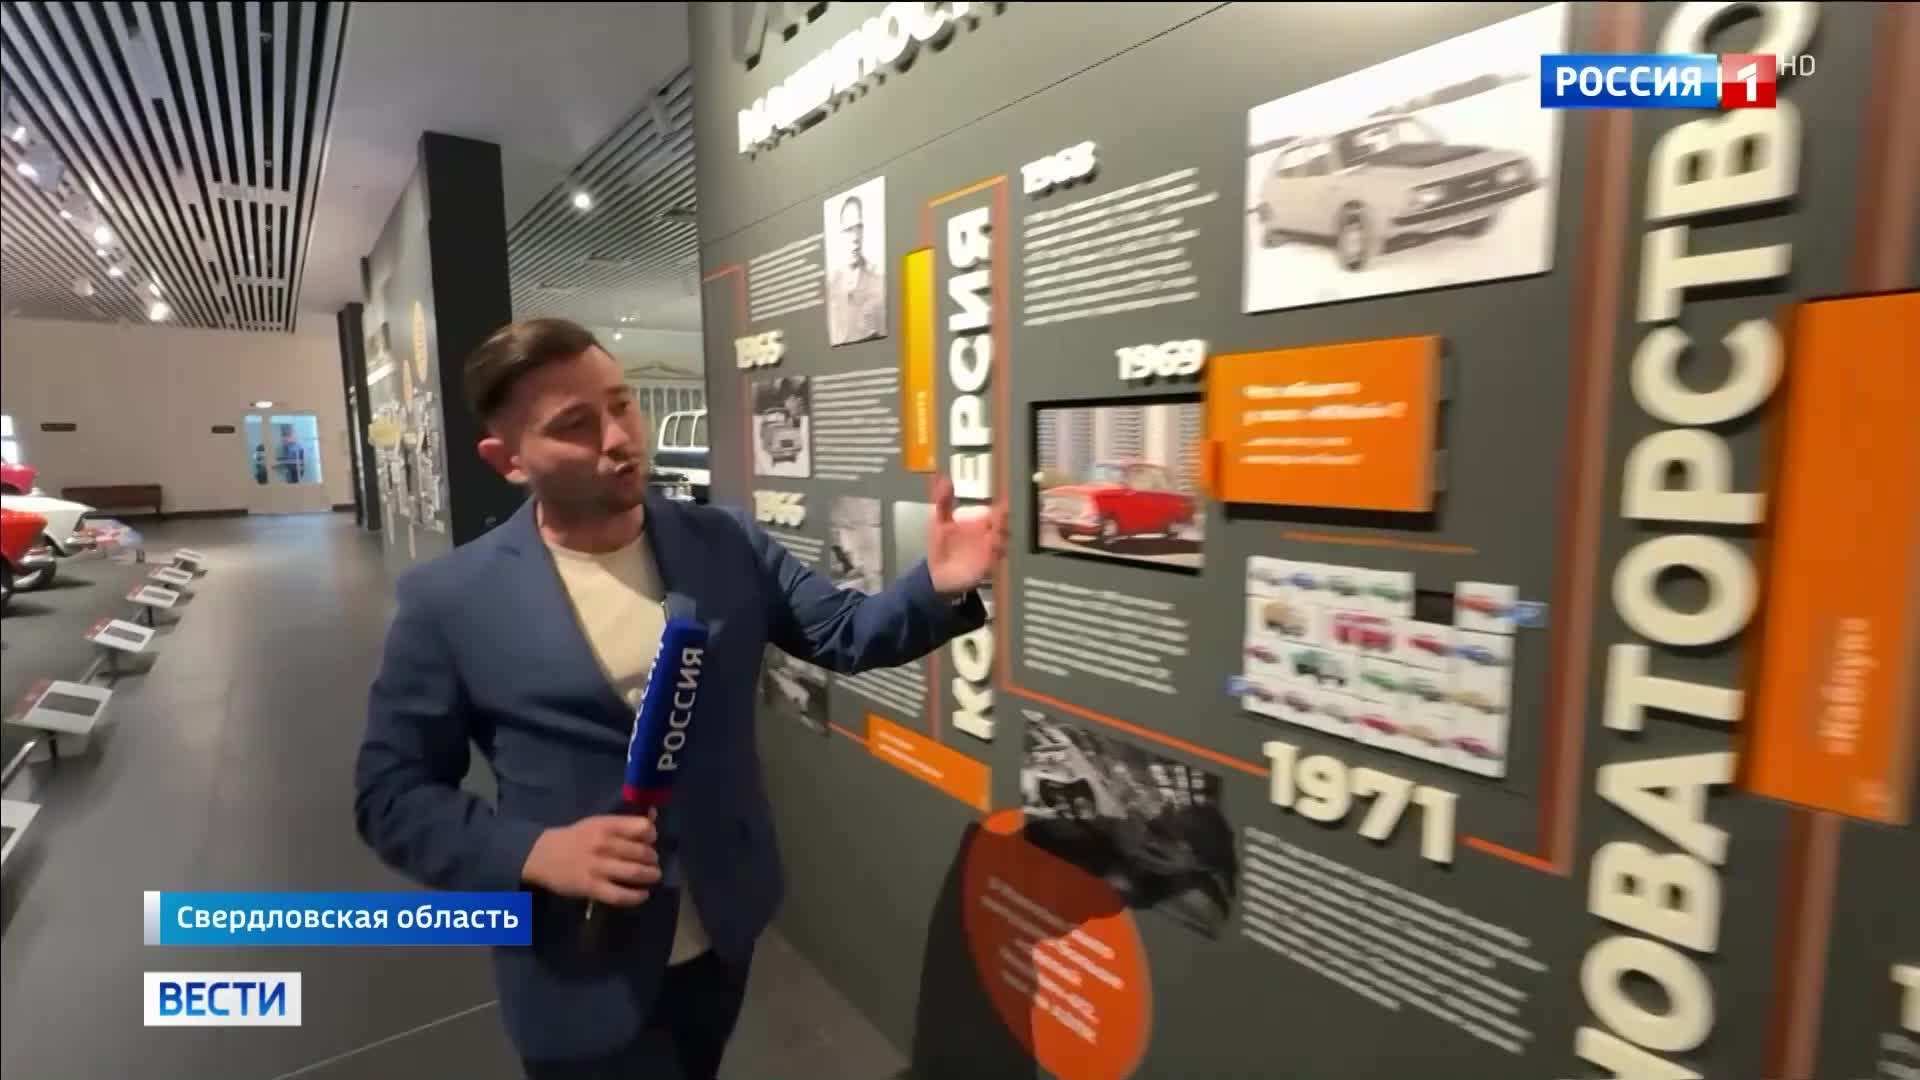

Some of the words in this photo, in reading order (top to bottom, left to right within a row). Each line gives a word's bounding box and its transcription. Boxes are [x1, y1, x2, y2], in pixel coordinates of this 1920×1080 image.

[1114, 339, 1206, 380] 1969
[947, 206, 994, 741] КОЕРСИЯ
[656, 647, 704, 771] РОССИЯ
[1262, 741, 1460, 864] 1971
